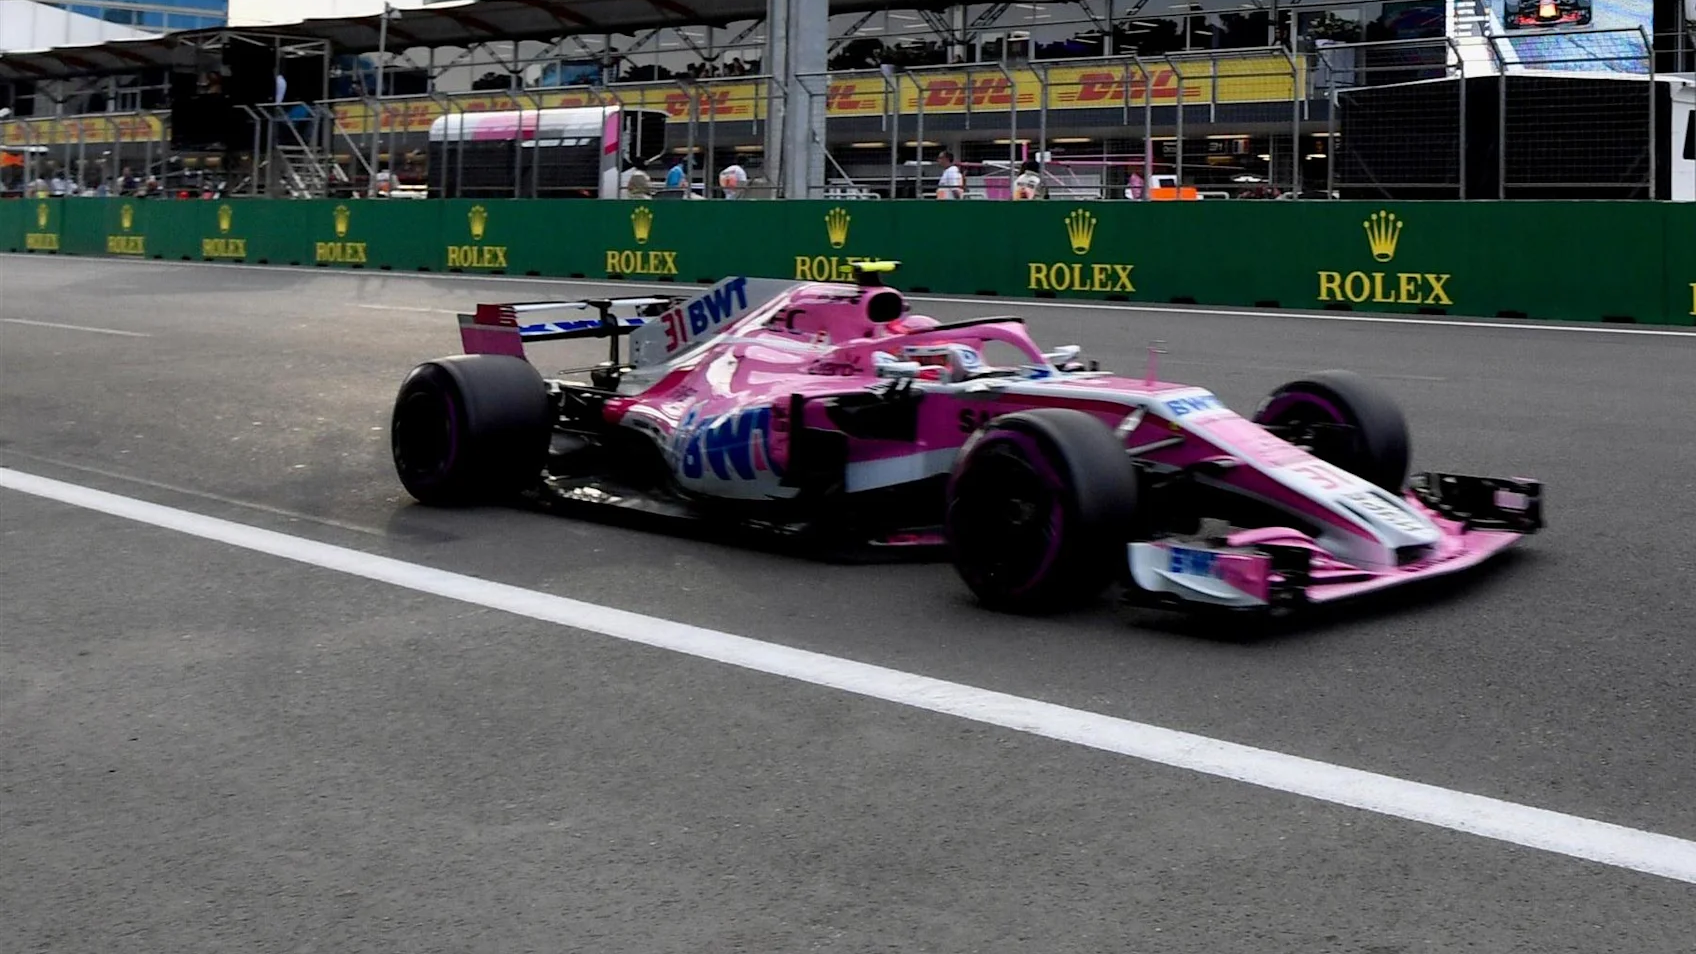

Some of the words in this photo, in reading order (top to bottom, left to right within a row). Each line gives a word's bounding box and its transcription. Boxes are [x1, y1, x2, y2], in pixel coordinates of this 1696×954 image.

[924, 78, 1012, 107] DHL
[1077, 69, 1177, 102] DHL
[202, 238, 246, 257] ROLEX
[316, 242, 367, 262] ROLEX
[447, 246, 507, 268] ROLEX
[605, 250, 678, 275] ROLEX
[794, 256, 881, 282] ROLE
[1028, 262, 1135, 293] ROLEX
[1318, 271, 1453, 305] ROLEX
[661, 308, 688, 353] 31
[688, 276, 750, 337] BWT
